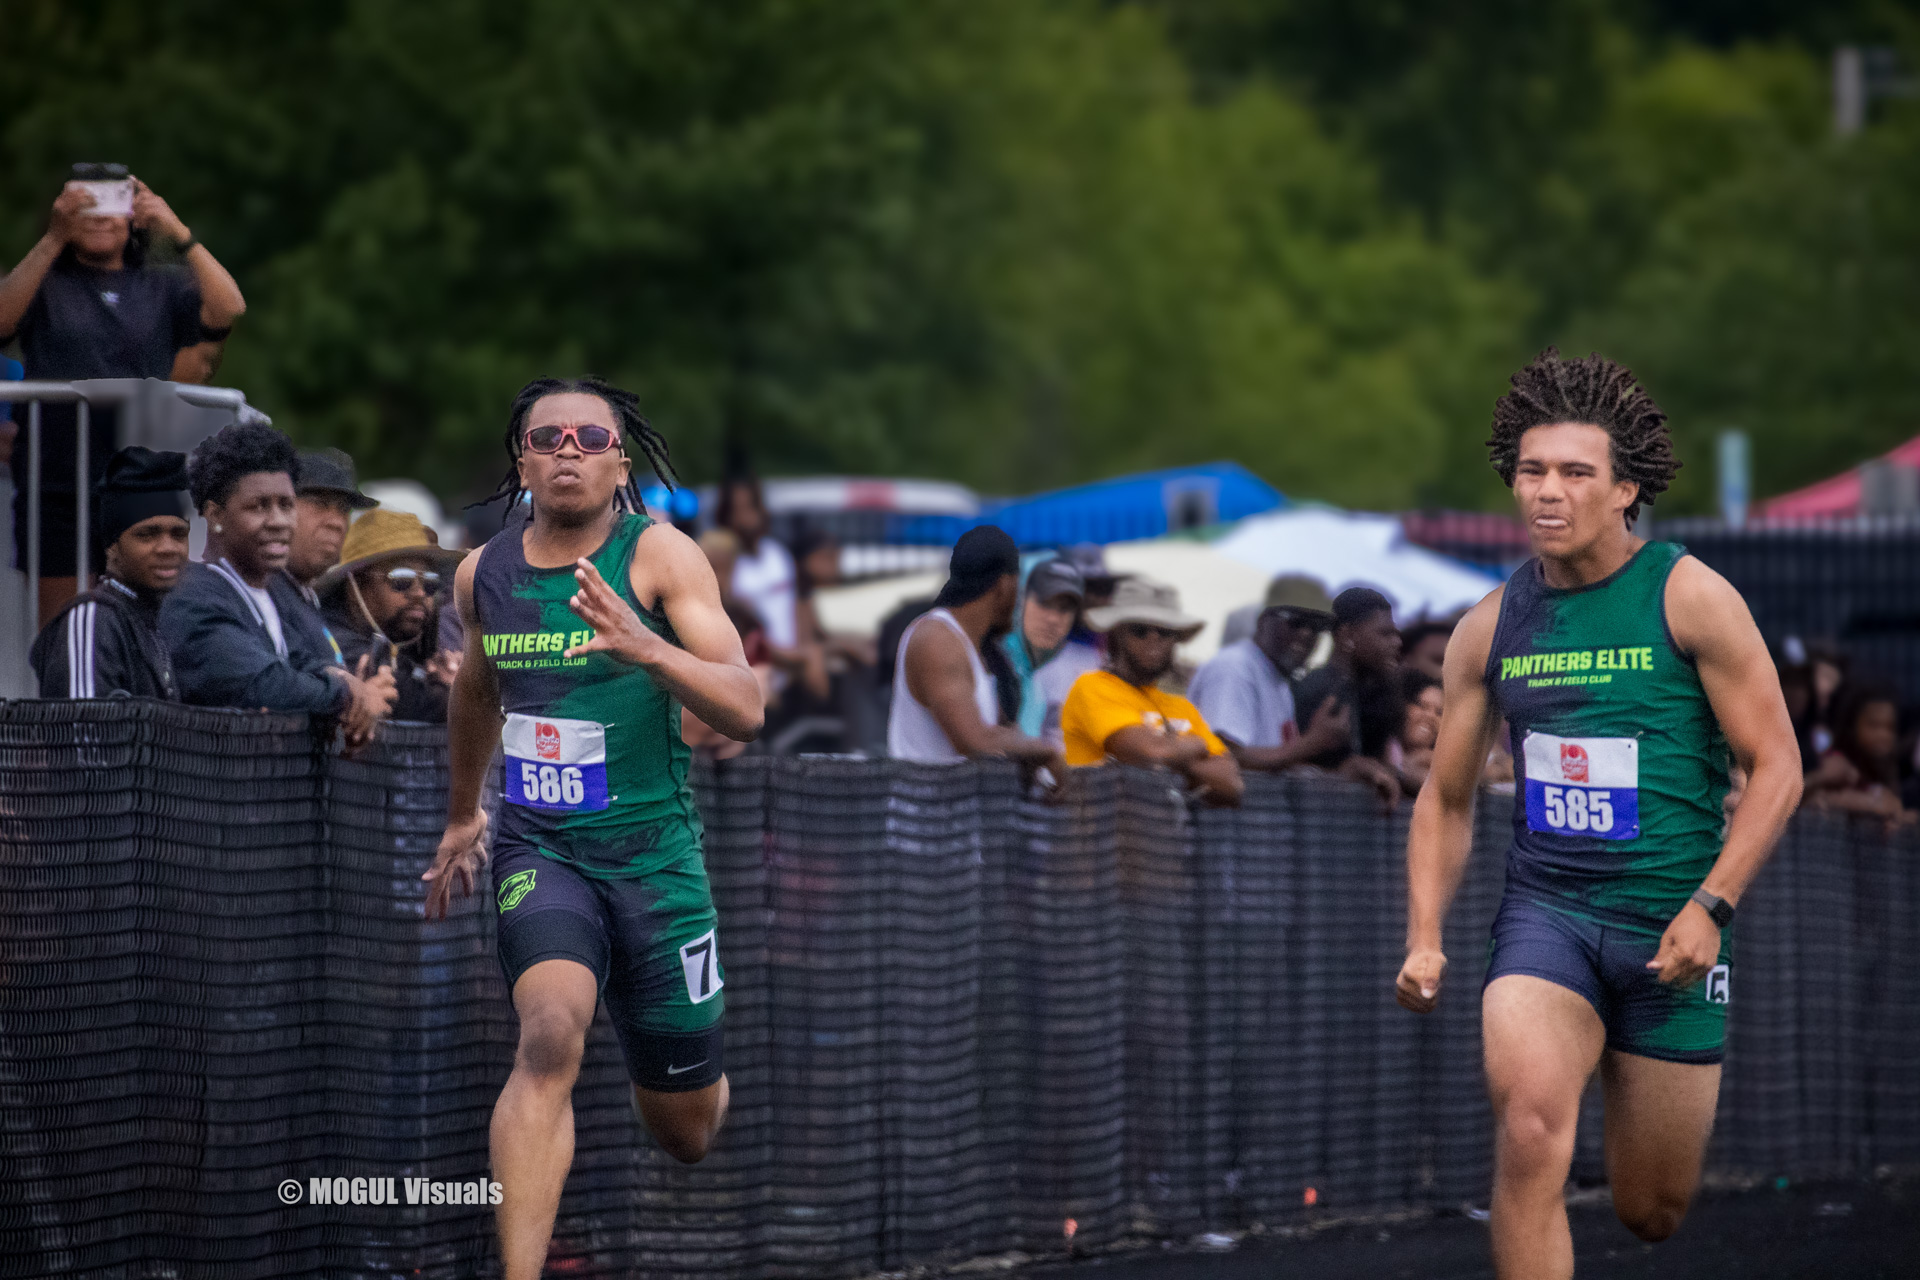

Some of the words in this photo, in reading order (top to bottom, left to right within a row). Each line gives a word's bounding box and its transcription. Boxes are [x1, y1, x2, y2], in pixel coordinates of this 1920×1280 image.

[482, 632, 565, 656] ANTHERS
[496, 660, 523, 669] TRACK
[524, 660, 531, 668] &
[533, 659, 560, 667] FIELD
[562, 657, 588, 666] CLUB
[1501, 651, 1592, 680] PANTHERS
[1596, 647, 1654, 671] ELITE
[1528, 677, 1554, 688] TRACK
[1561, 676, 1588, 686] FIELD
[1589, 674, 1612, 684] CLUB
[521, 762, 584, 805] 586
[1544, 785, 1614, 832] 585
[685, 936, 712, 997] 7
